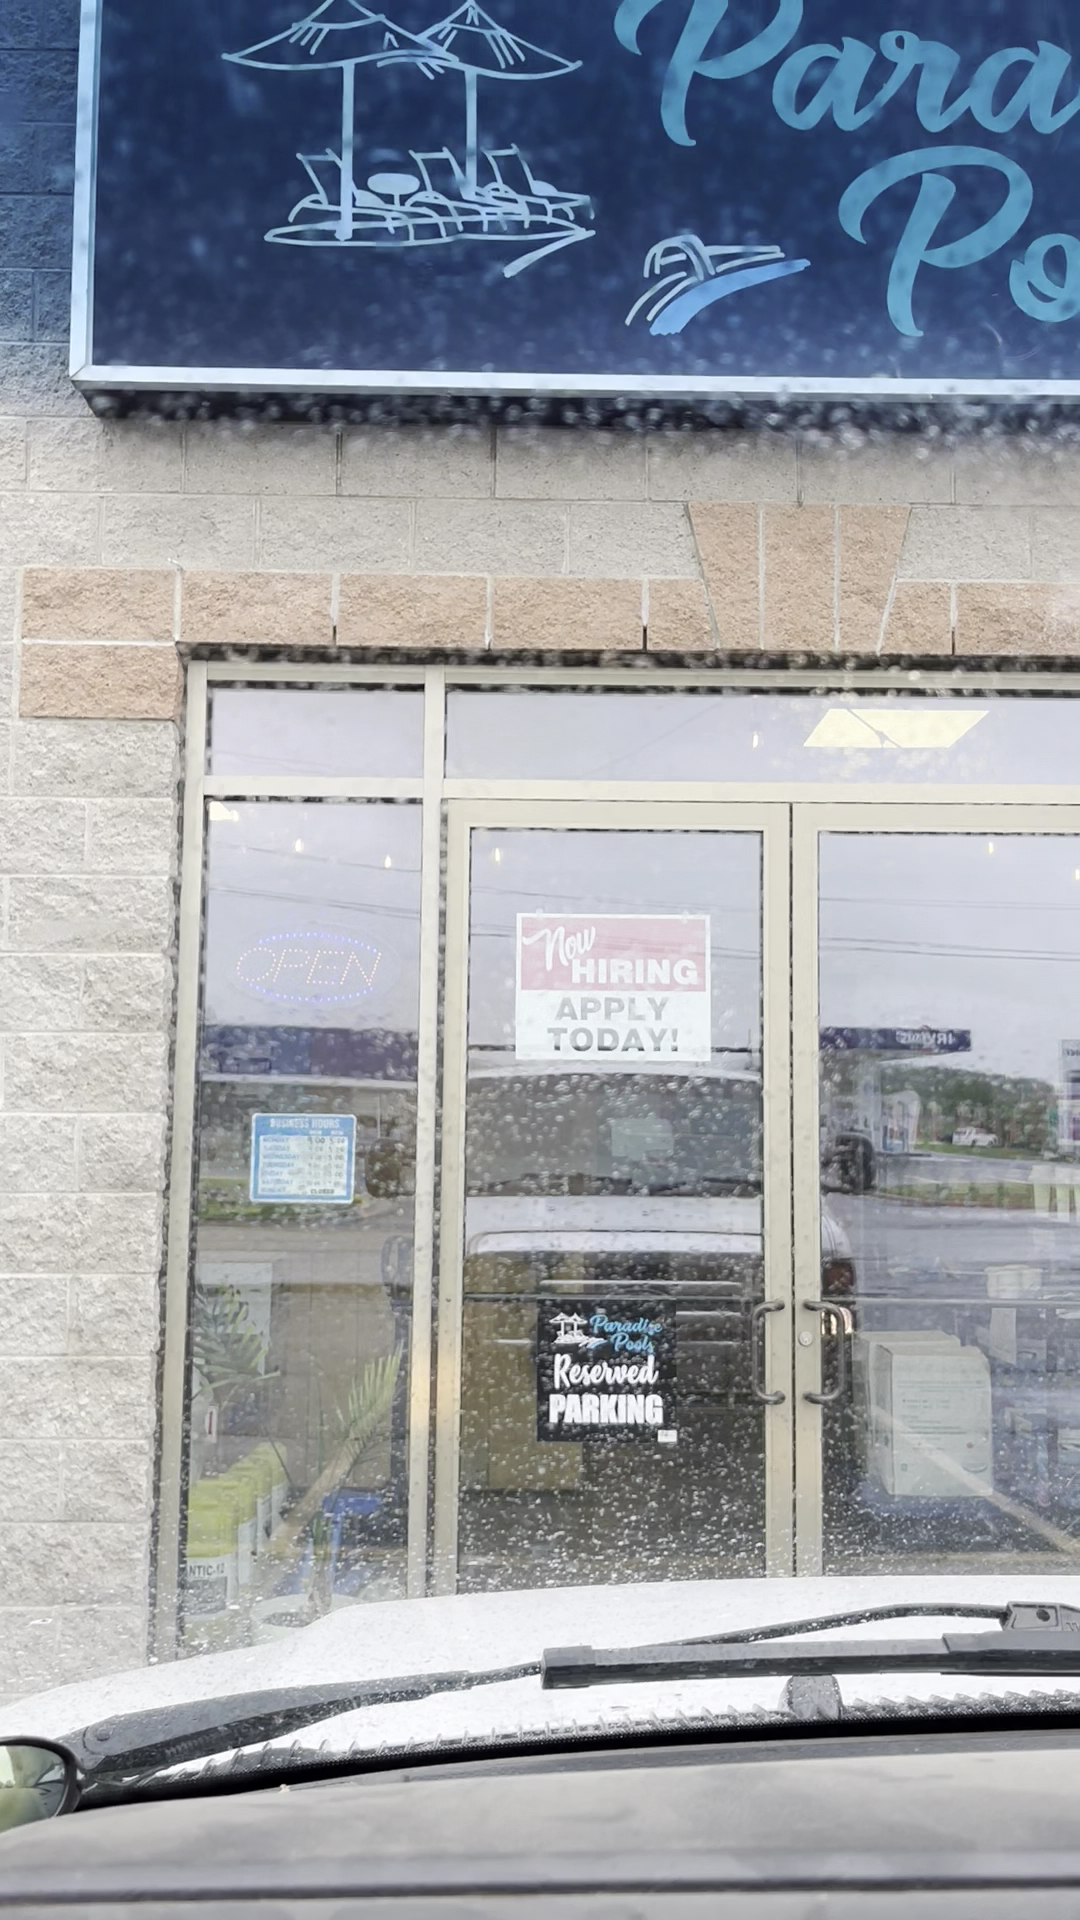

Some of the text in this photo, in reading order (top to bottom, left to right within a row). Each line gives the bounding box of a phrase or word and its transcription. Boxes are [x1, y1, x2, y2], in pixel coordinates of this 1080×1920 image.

[522, 926, 596, 971] Now
[236, 947, 382, 986] OPEN
[572, 958, 698, 985] HIRING
[554, 996, 669, 1021] APPLY
[547, 1027, 678, 1052] TODAY!
[311, 1119, 340, 1129] HOURS
[589, 1314, 663, 1335] Paradise
[610, 1332, 655, 1353] Pools
[553, 1353, 659, 1389] Reserved
[549, 1394, 664, 1424] PARKING
